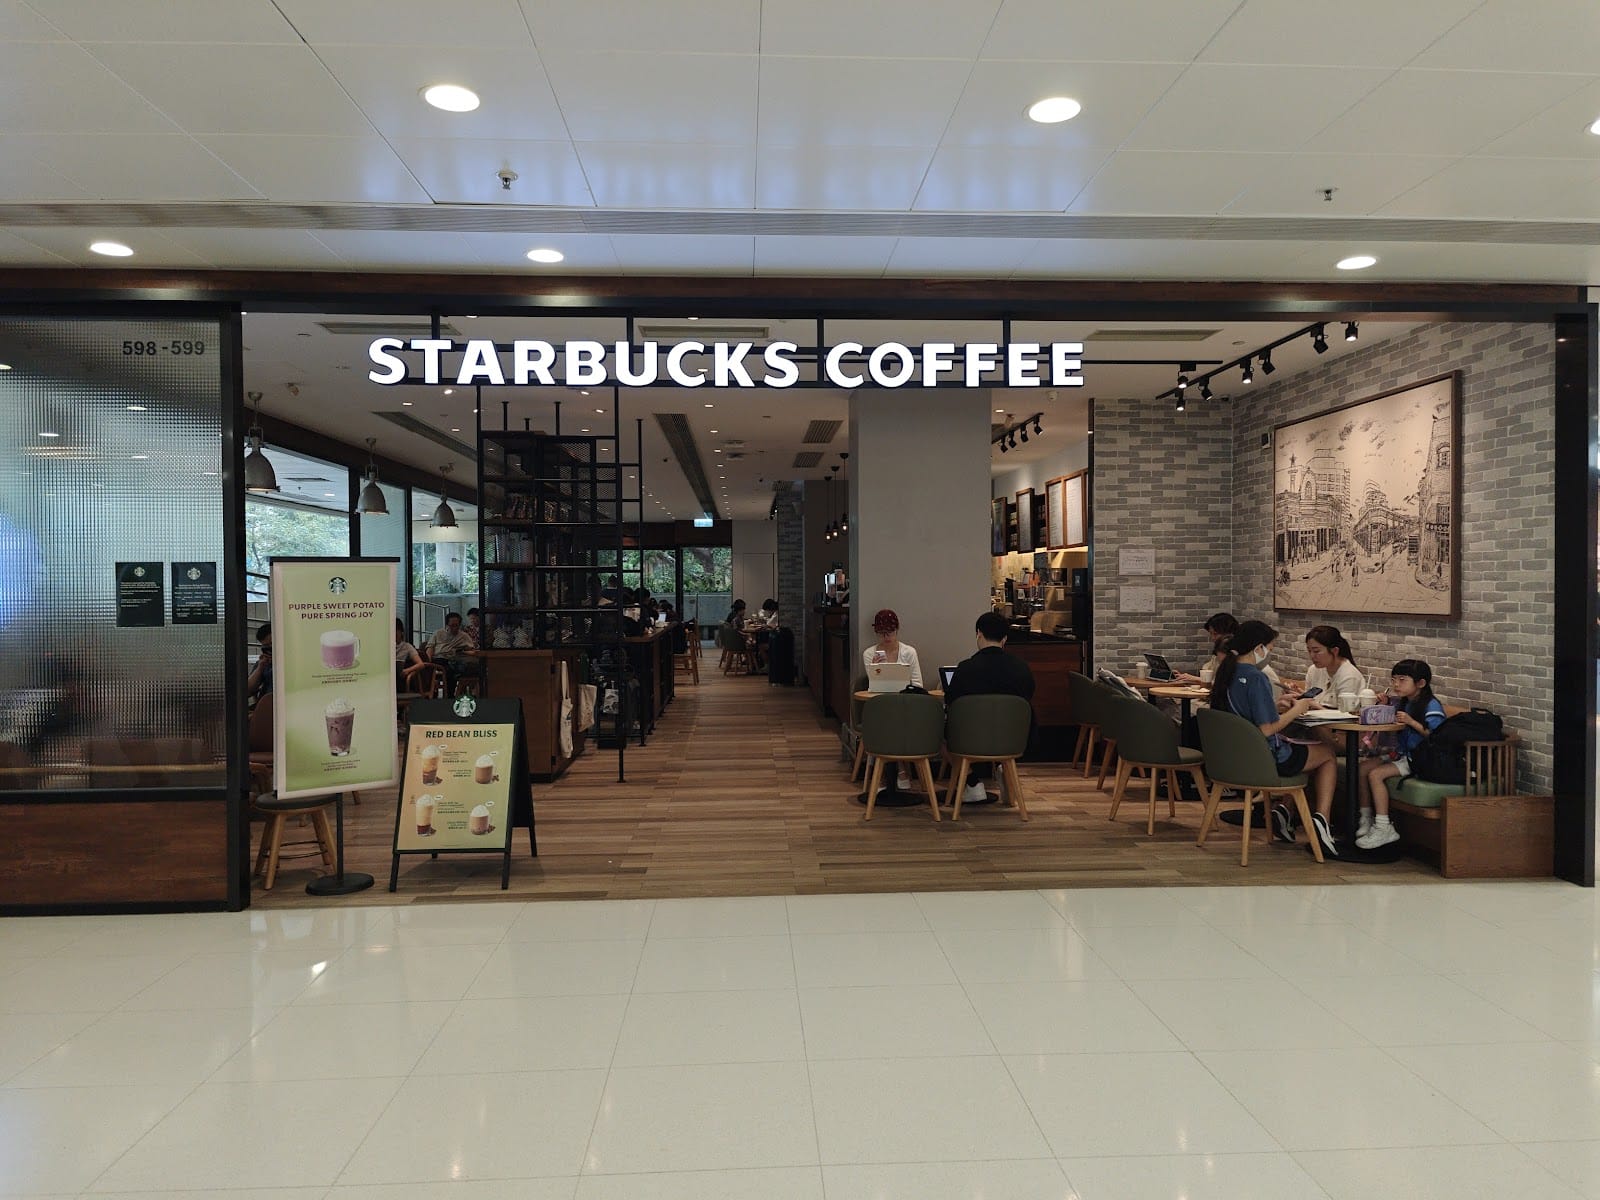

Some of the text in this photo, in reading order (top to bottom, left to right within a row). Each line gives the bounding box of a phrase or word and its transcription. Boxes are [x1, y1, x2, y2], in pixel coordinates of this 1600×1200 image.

[368, 337, 1084, 388] STARBUCKS COFFEE
[288, 603, 321, 611] PURPLE
[323, 602, 352, 610] SWEET
[301, 612, 324, 620] PURE
[425, 729, 498, 739] RED BEAN BLISS
